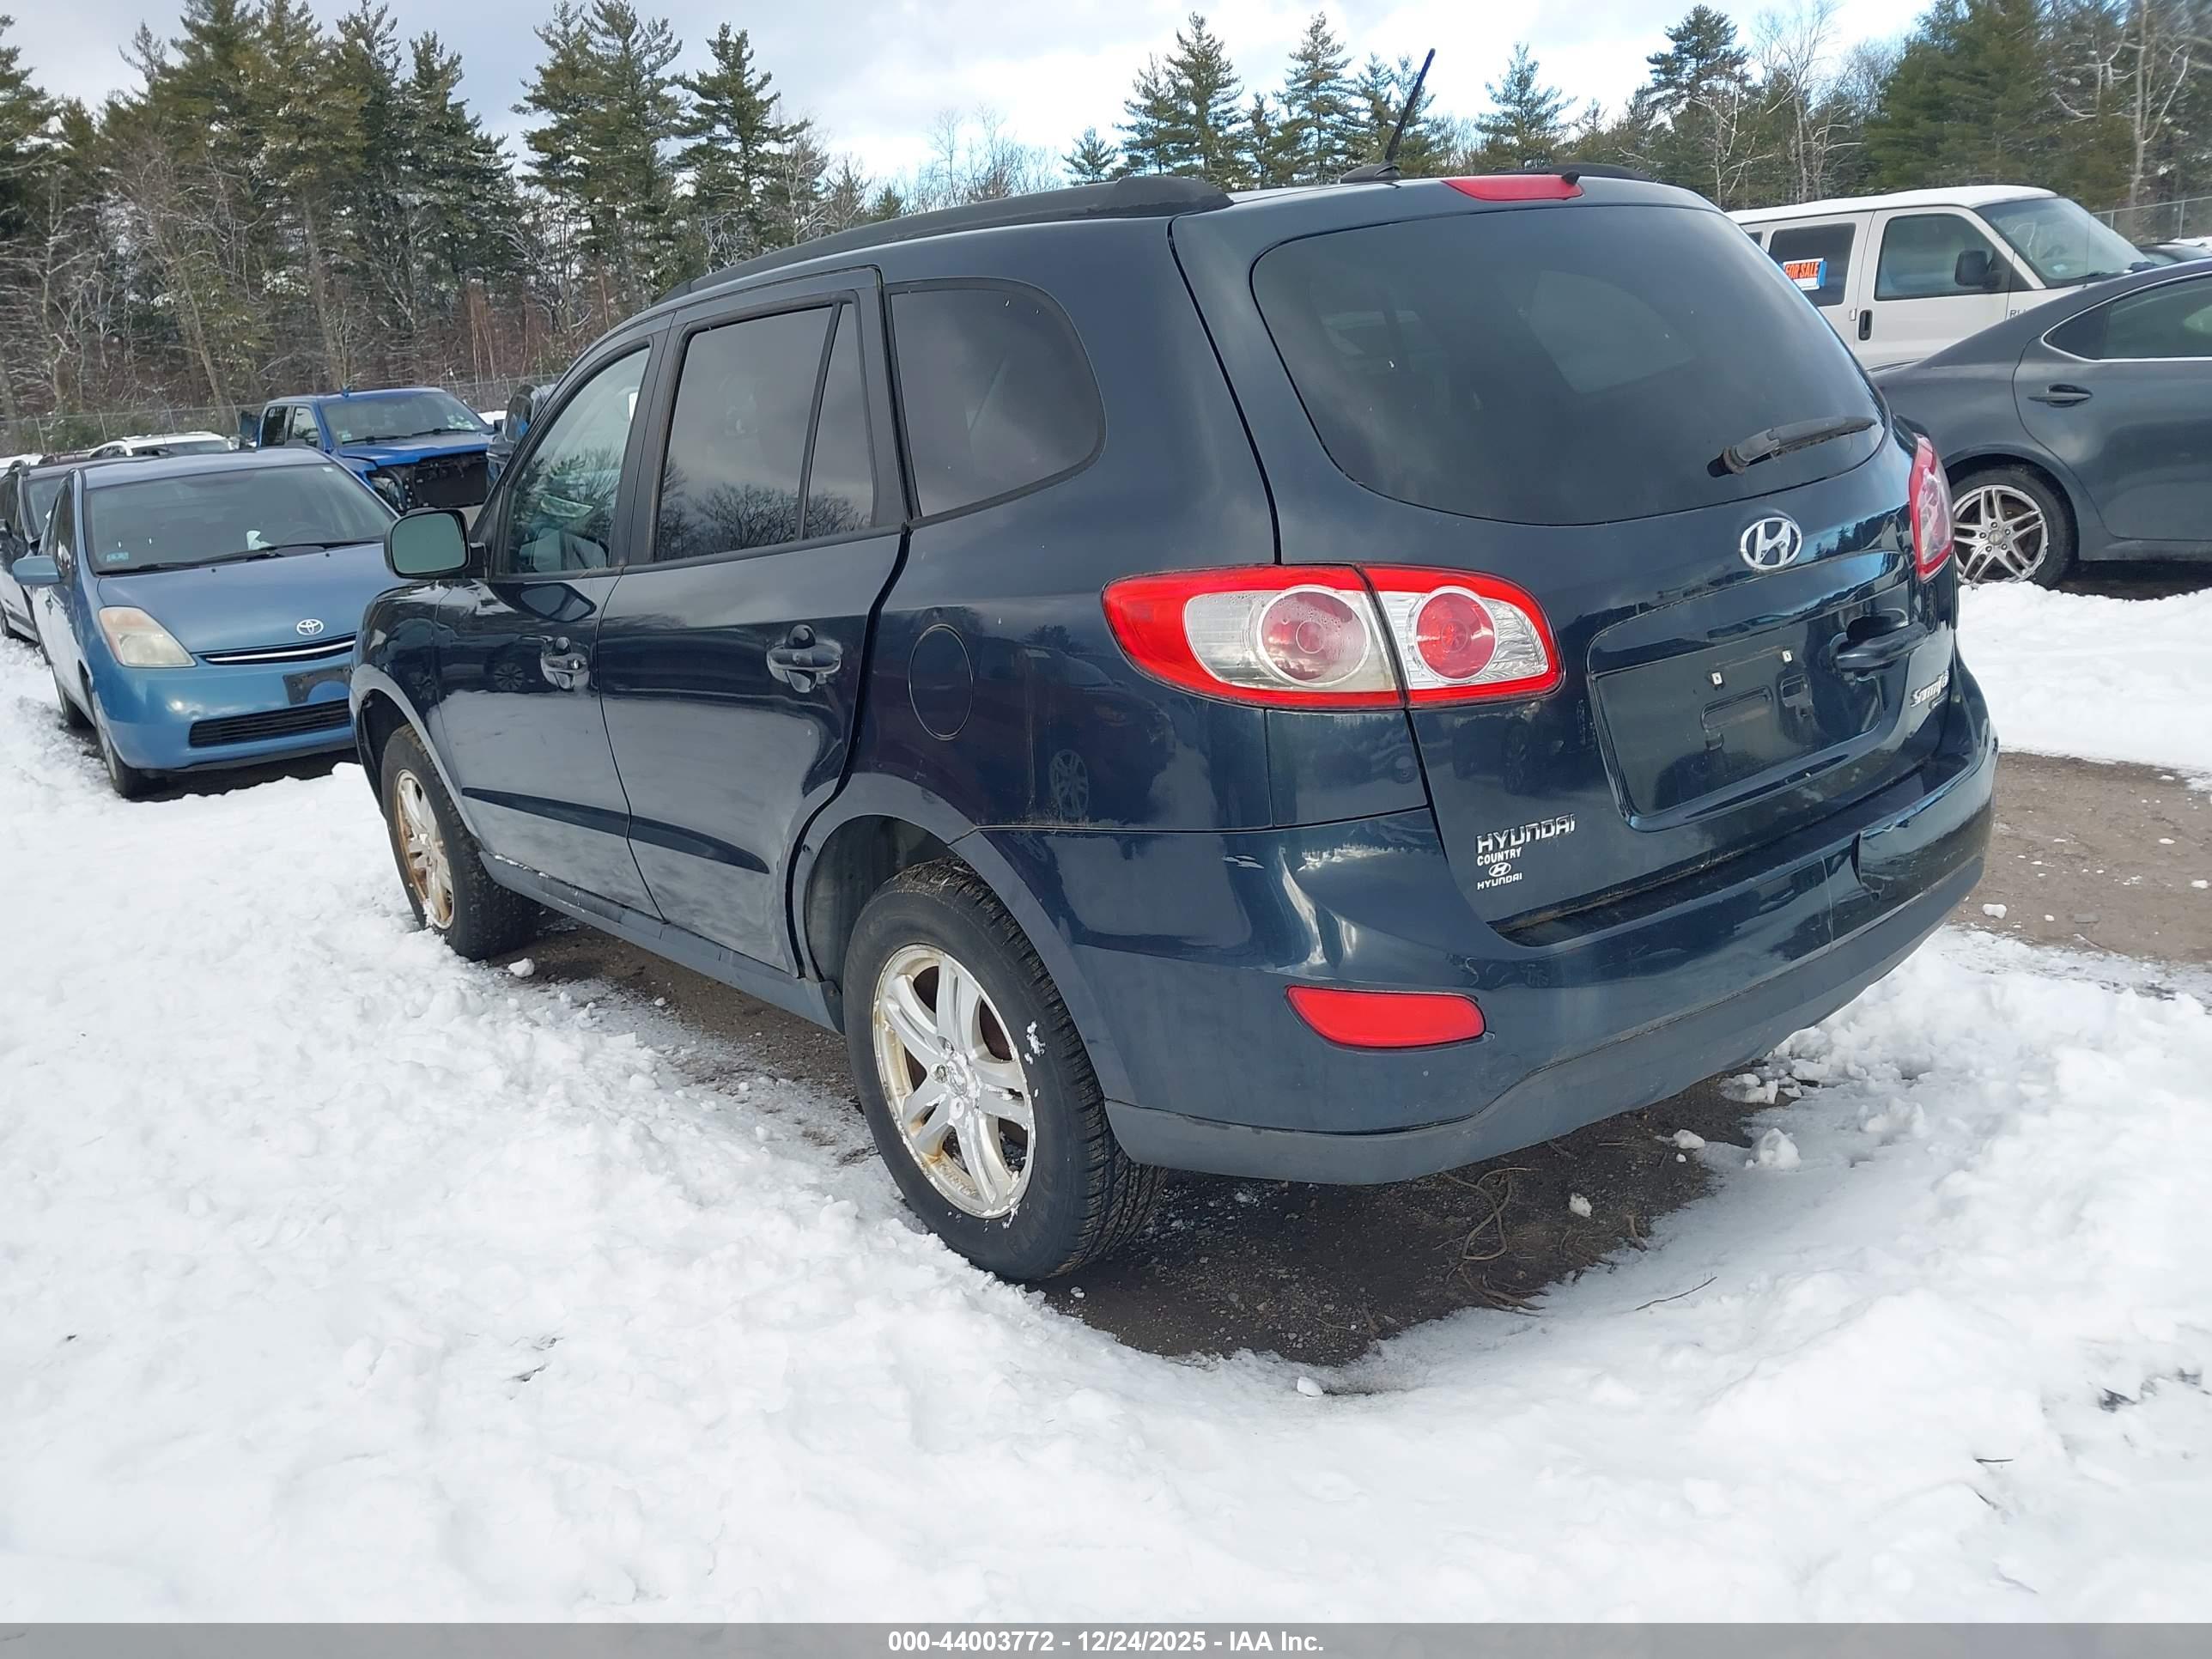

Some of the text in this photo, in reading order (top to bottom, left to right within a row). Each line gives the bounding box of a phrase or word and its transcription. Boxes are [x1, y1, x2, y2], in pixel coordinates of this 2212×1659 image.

[1785, 261, 1819, 279] FOR SALE
[1476, 813, 1577, 854] HYUNDAI
[1476, 847, 1522, 866] COUNTRY
[1476, 872, 1523, 890] HYUNDAI
